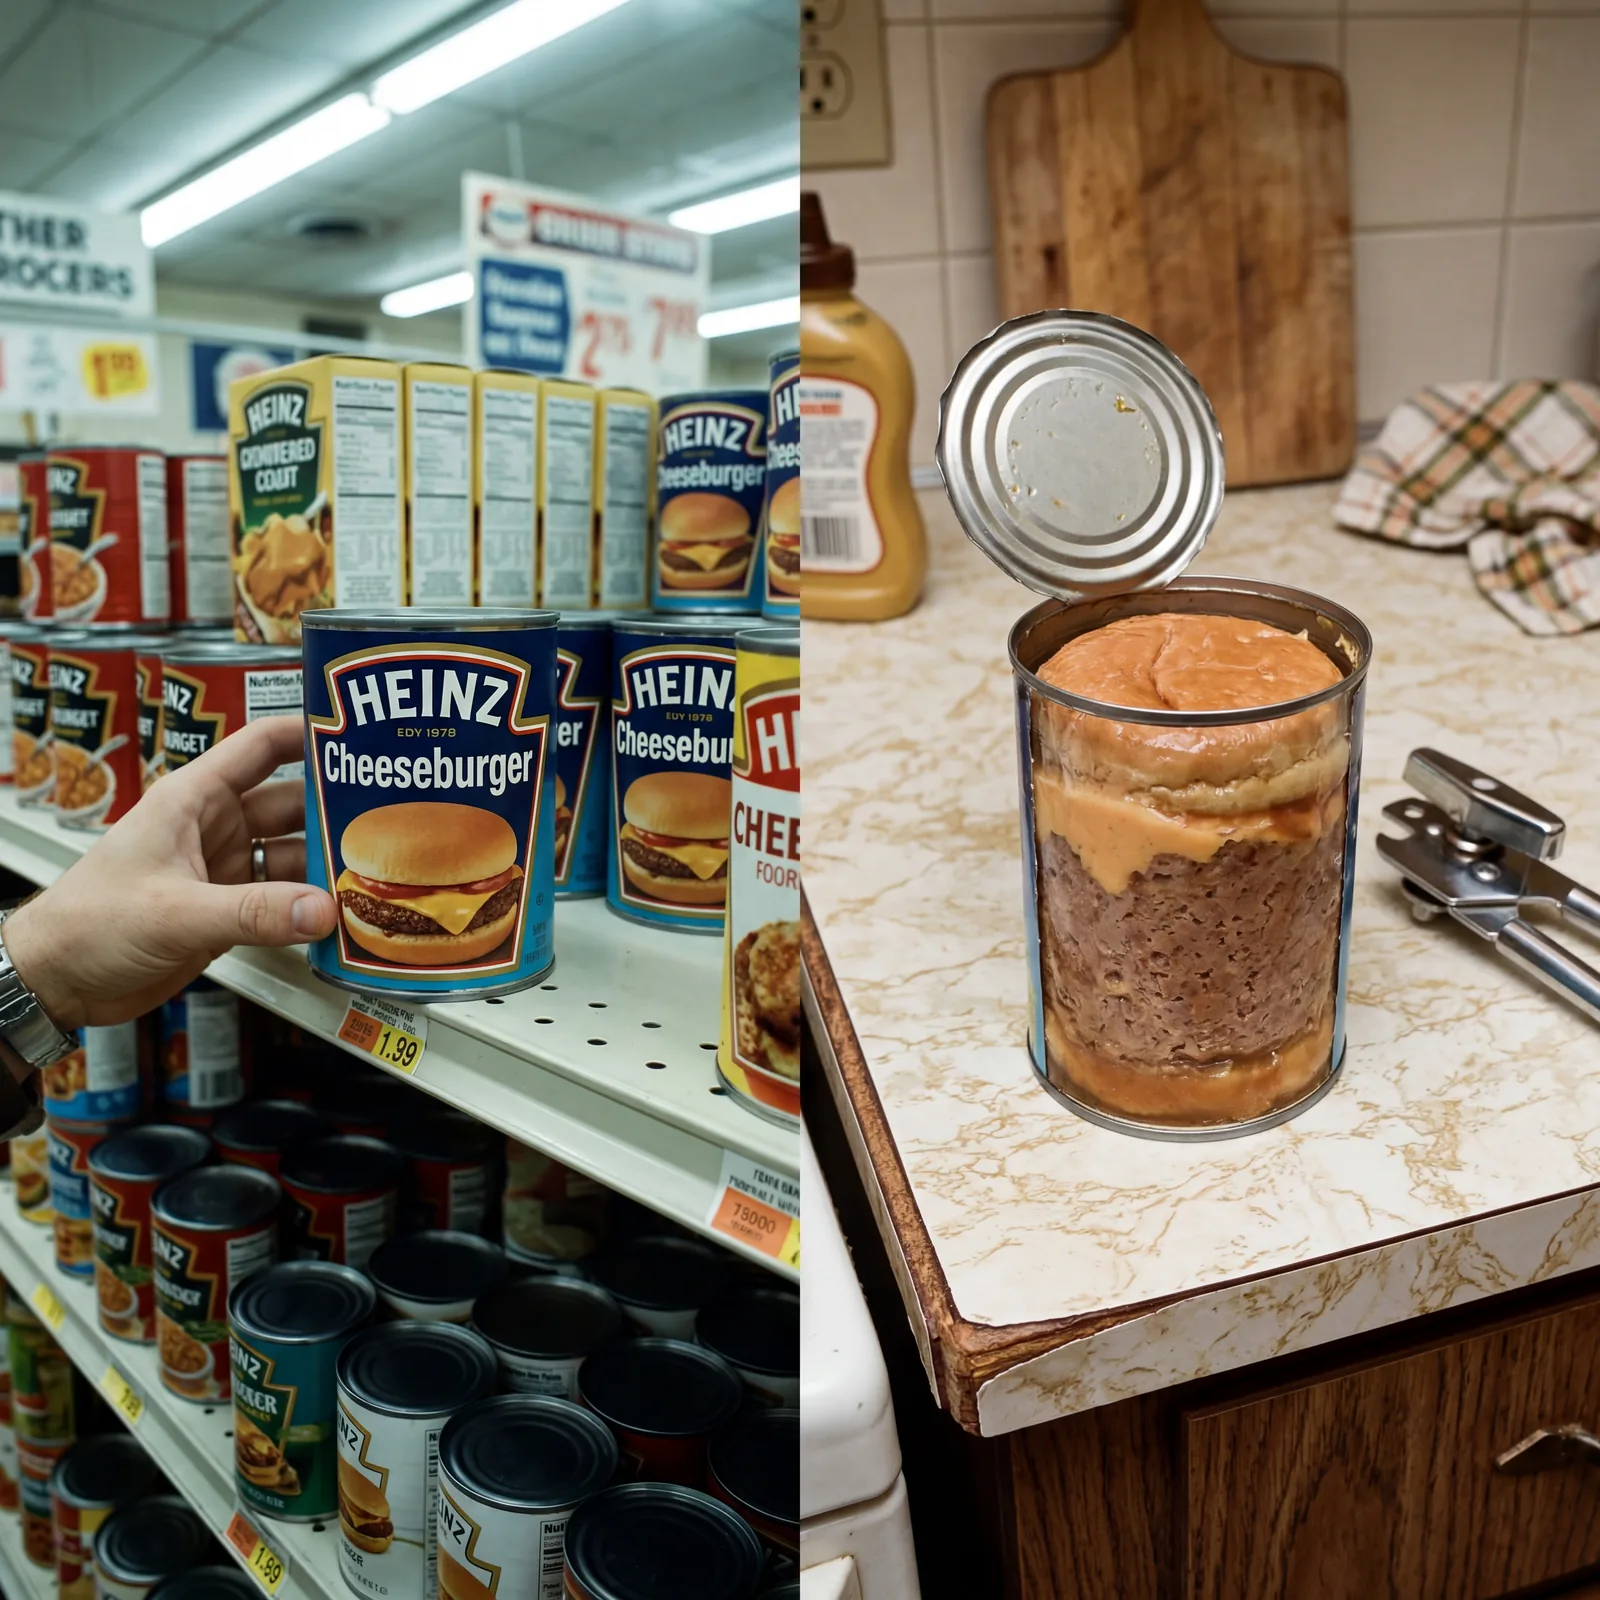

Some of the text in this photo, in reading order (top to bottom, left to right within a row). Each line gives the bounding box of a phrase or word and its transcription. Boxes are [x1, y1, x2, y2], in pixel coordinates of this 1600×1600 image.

[247, 393, 304, 436] HEINZ
[665, 416, 747, 455] HEINZ
[249, 675, 294, 687] Nutrition
[347, 668, 509, 727] HEINZ
[632, 665, 735, 713] HEIN
[397, 727, 457, 738] EDY 1978
[688, 713, 713, 722] 1978
[324, 740, 533, 796] Cheeseburger
[379, 1030, 418, 1066] 1.99
[255, 1546, 281, 1584] 1.89
